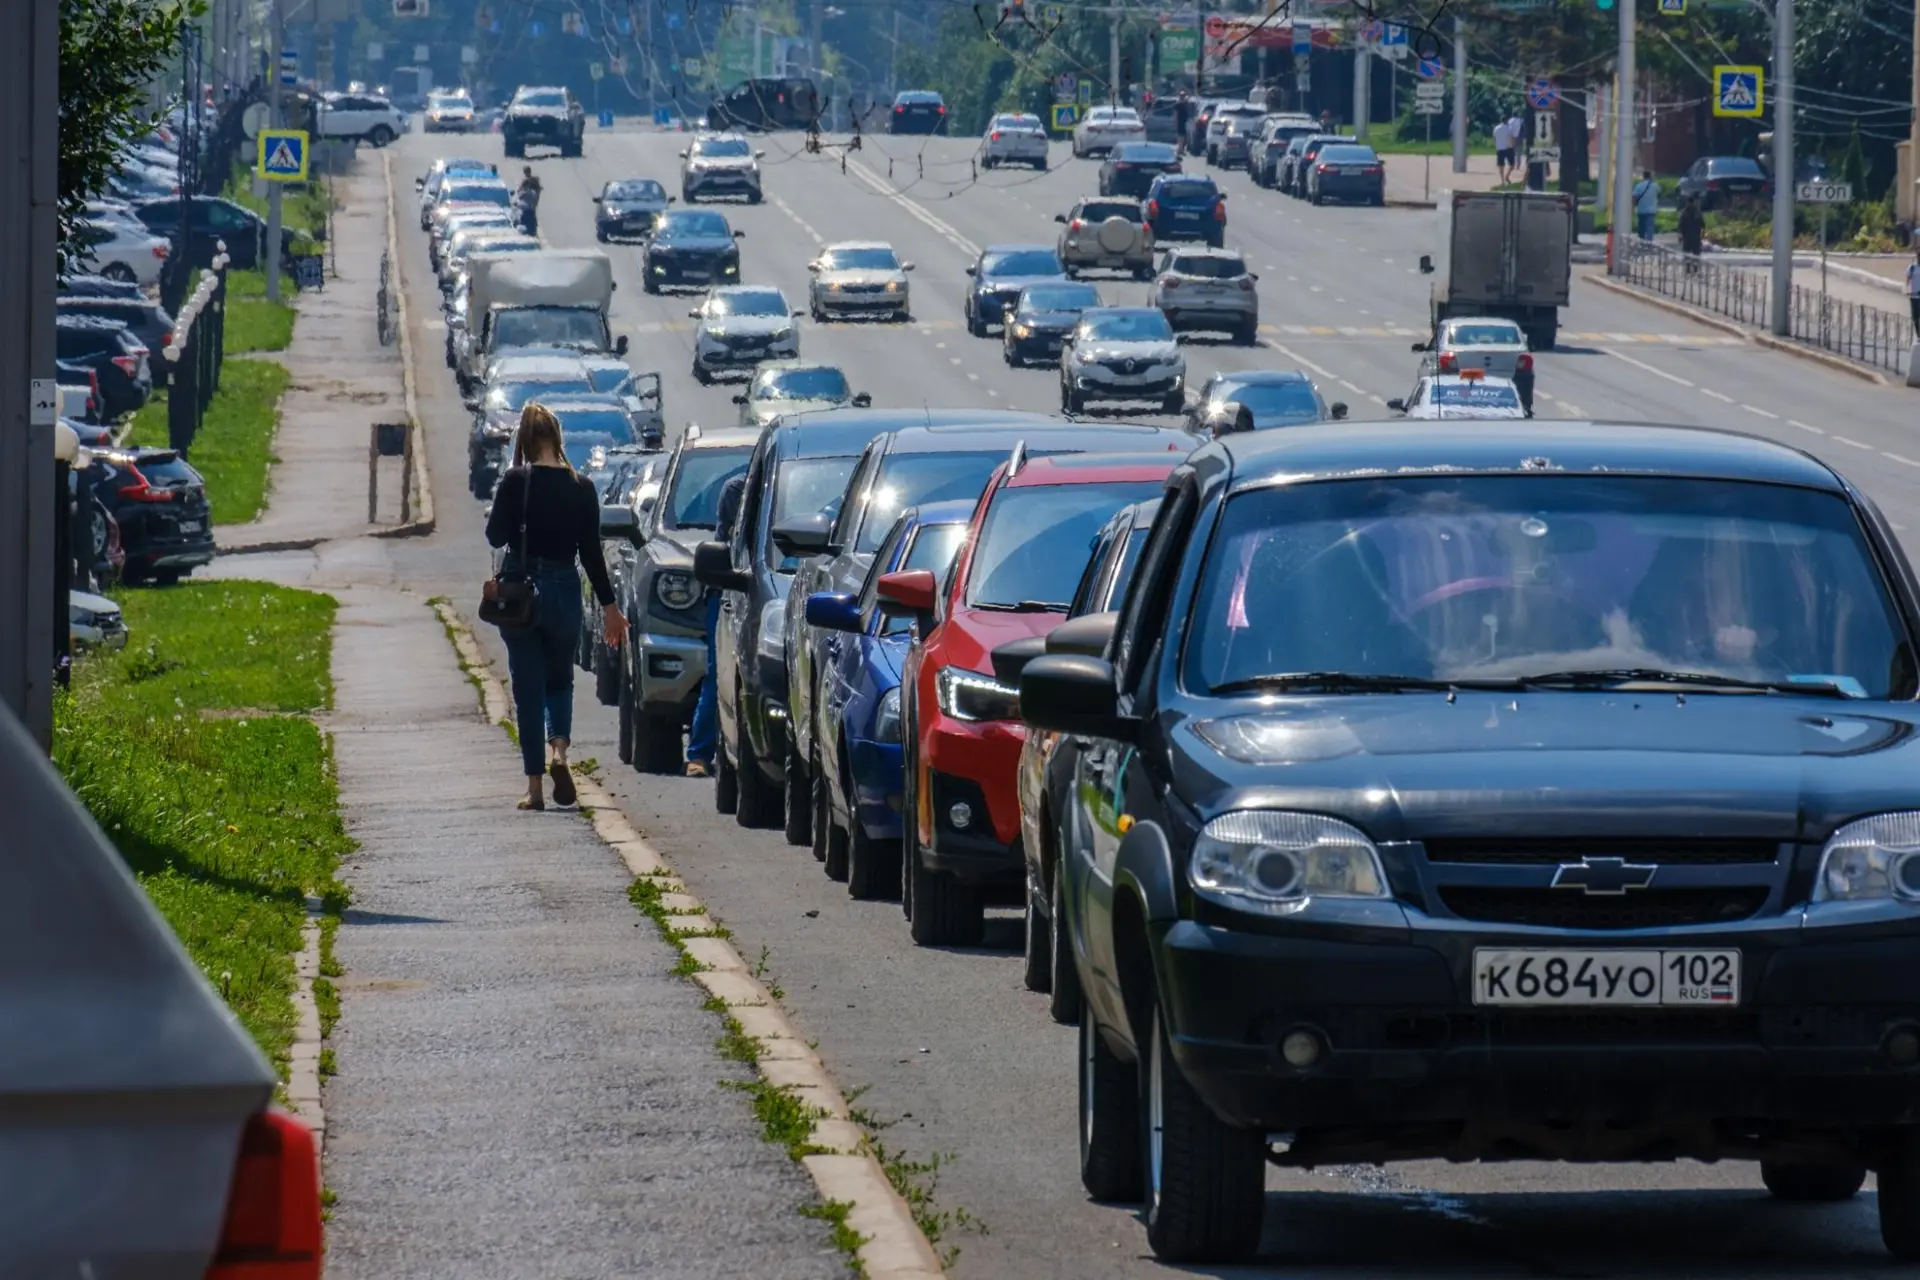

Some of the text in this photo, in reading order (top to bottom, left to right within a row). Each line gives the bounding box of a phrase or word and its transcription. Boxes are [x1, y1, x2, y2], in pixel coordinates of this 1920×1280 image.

[1802, 185, 1847, 199] СТОП
[1669, 955, 1732, 986] 102
[1679, 988, 1709, 1000] RUS
